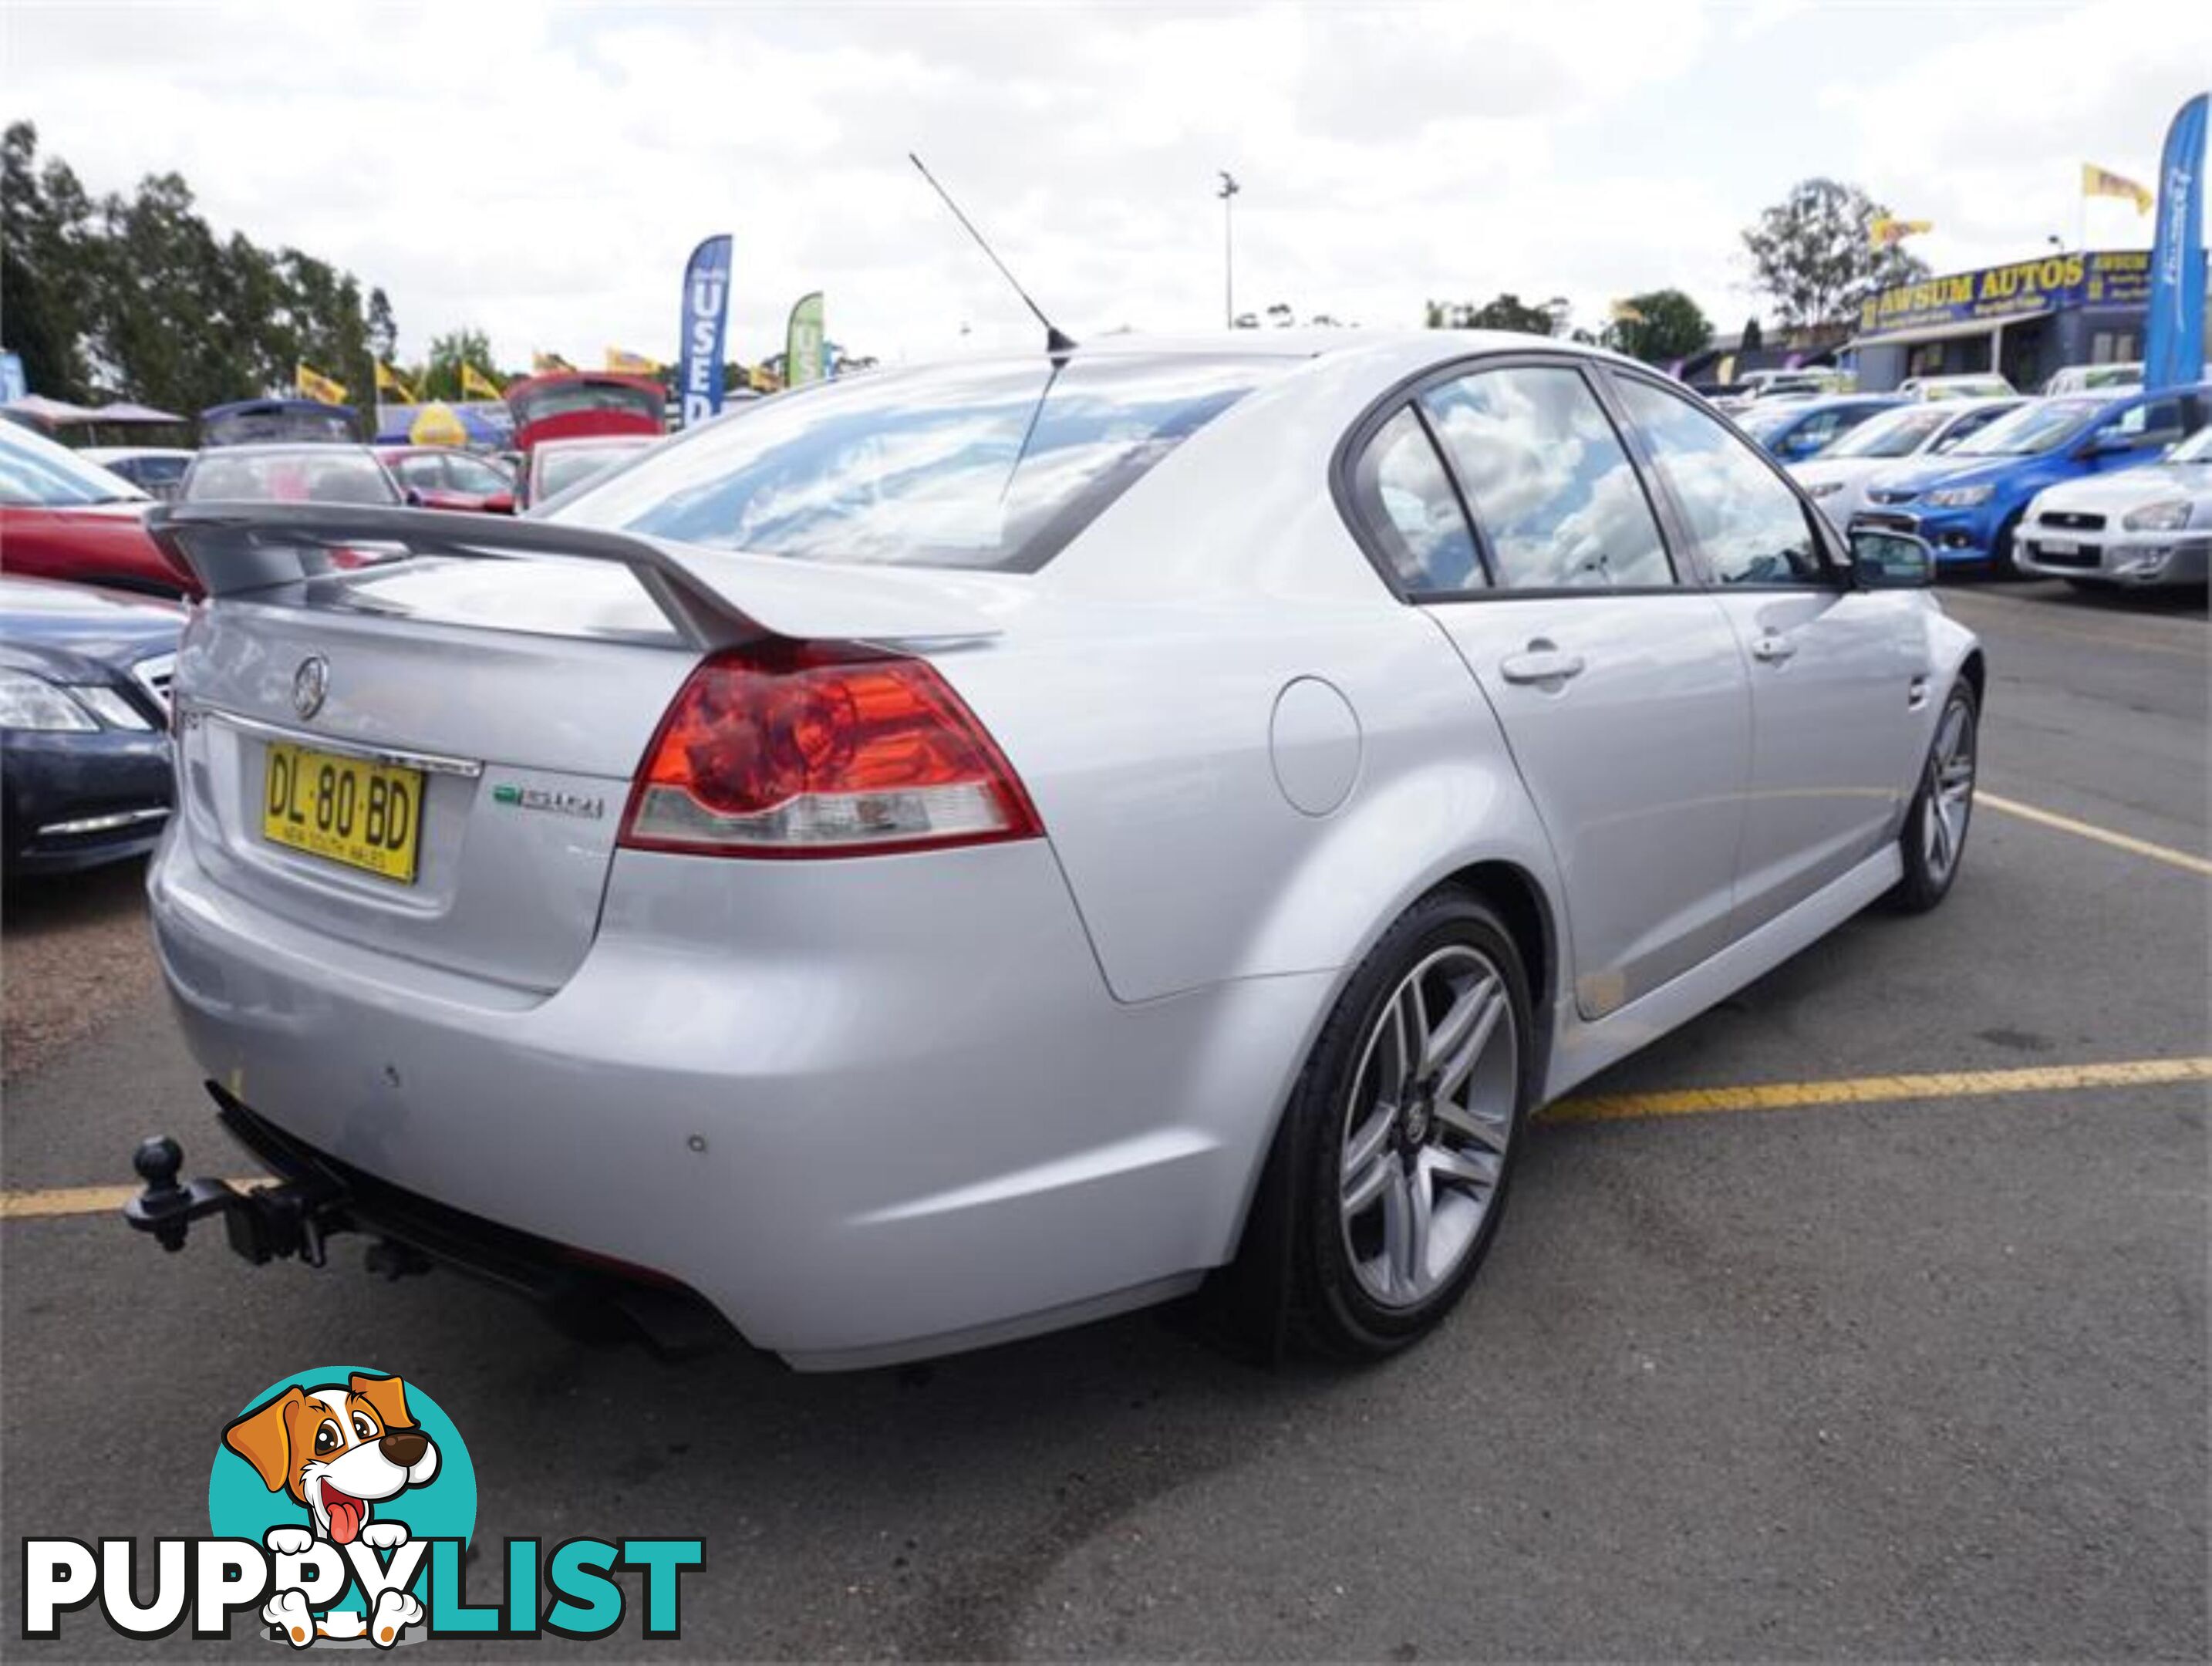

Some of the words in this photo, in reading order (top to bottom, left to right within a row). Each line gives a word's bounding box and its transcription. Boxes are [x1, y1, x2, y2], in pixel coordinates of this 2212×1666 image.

[1878, 273, 1974, 314] AWSUM
[1978, 255, 2084, 299] AUTOS
[685, 282, 722, 430] USED
